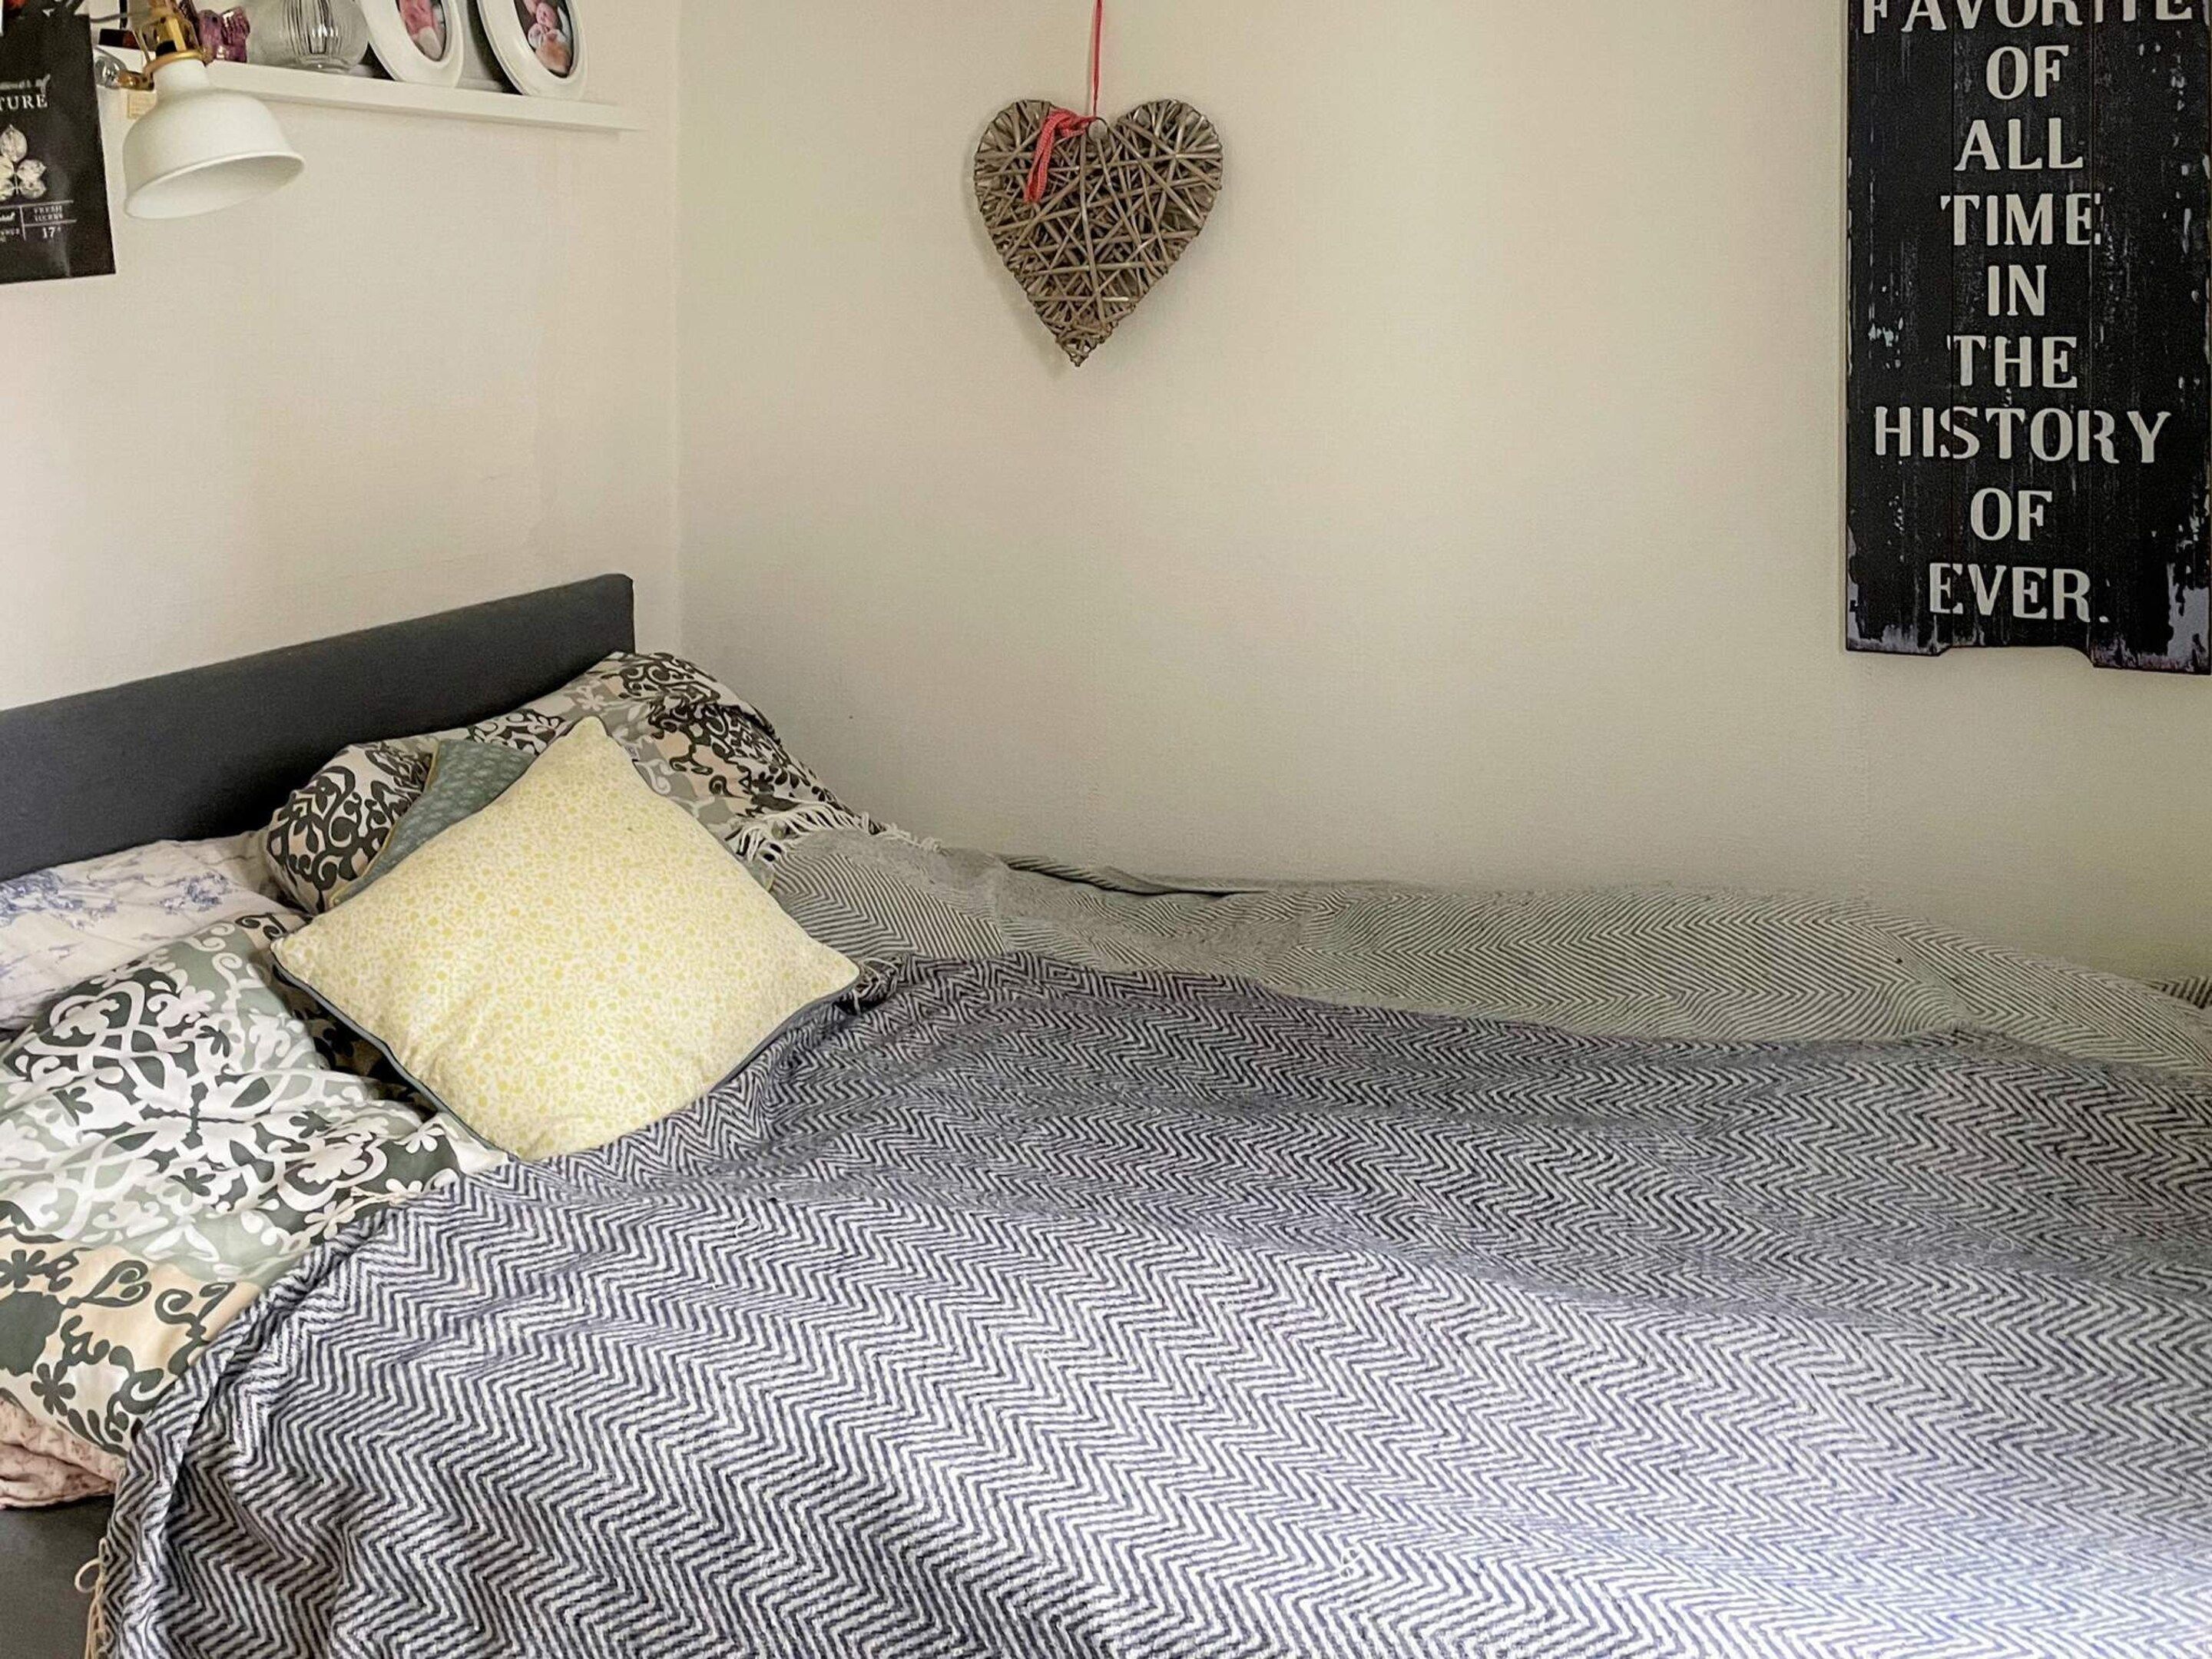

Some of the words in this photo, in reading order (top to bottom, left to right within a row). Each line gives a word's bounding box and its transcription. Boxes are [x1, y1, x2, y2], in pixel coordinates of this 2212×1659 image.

[1986, 45, 2069, 100] OF
[1954, 118, 2084, 171] ALL
[1940, 193, 2101, 246] TIME
[1988, 264, 2047, 316] IN
[1947, 335, 2078, 389] THE
[1876, 406, 2171, 464] HISTORY
[1970, 488, 2053, 541] OF
[1929, 563, 2109, 623] EVER.
